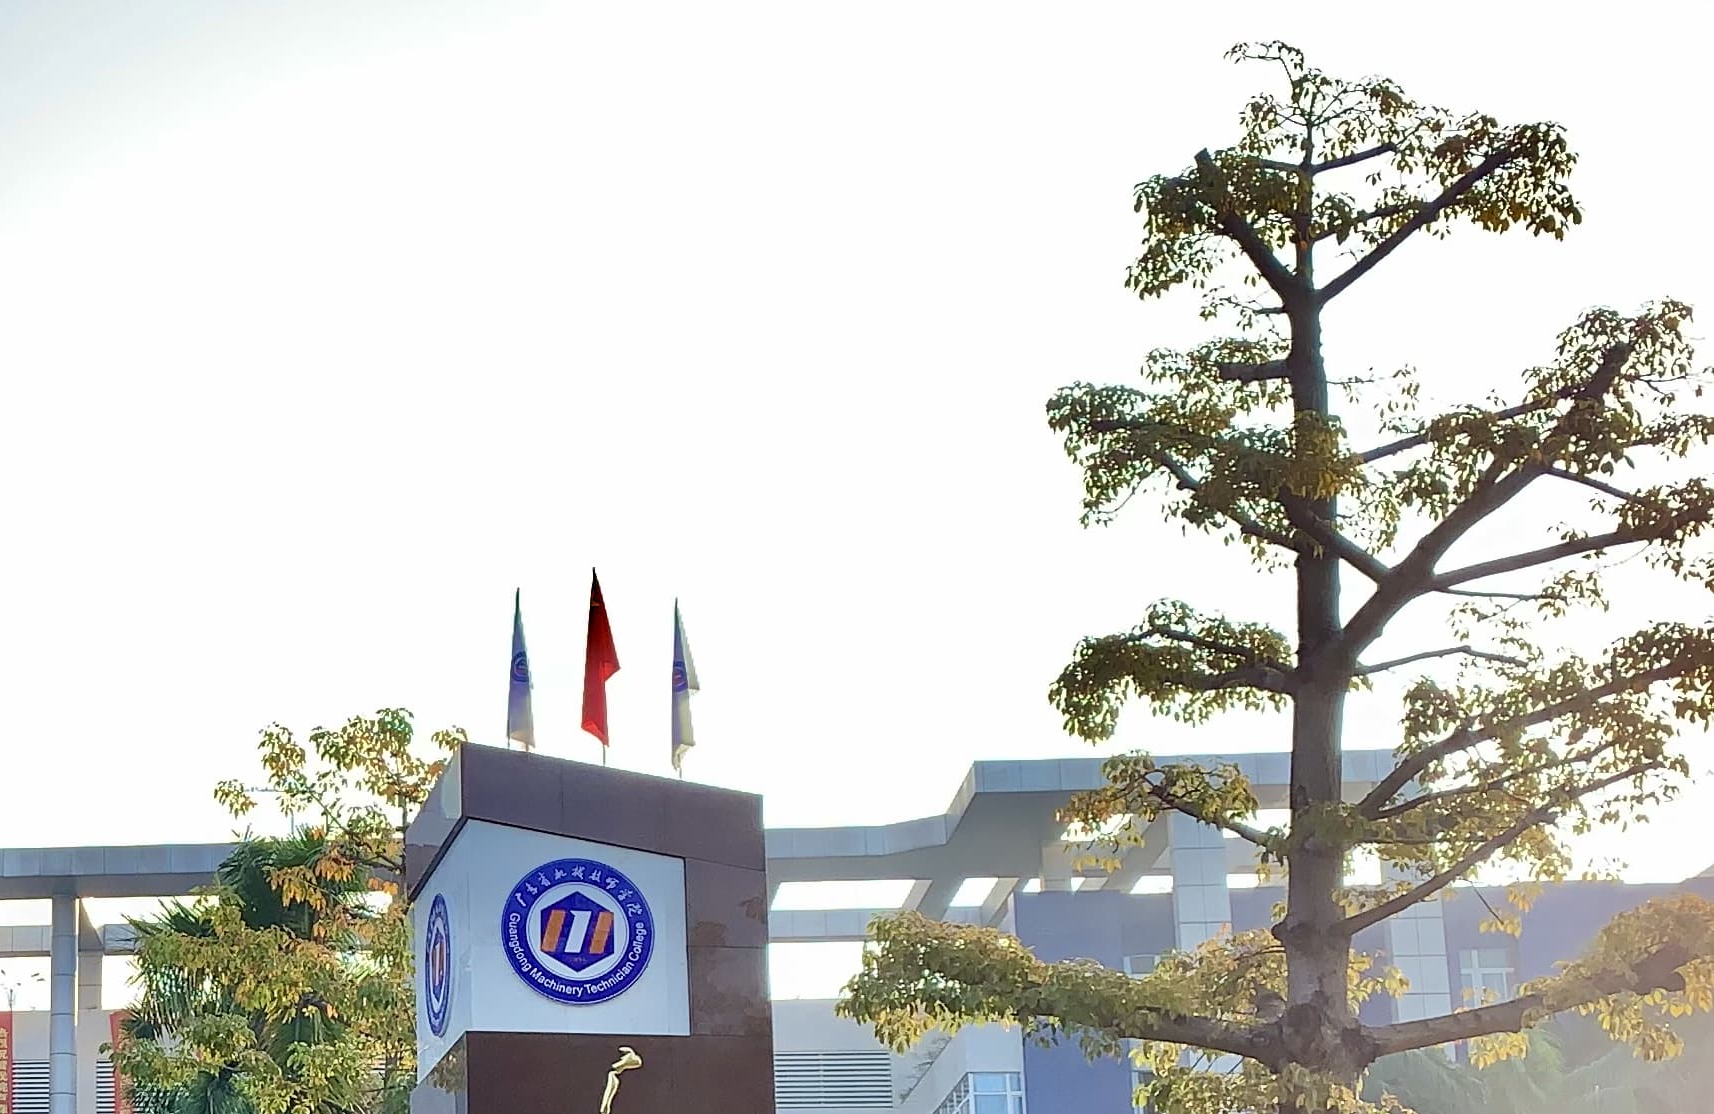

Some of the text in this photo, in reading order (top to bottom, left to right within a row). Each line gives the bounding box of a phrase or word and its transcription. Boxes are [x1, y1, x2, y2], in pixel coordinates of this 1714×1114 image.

[508, 912, 648, 998] Guangdong Machinery Technician College
